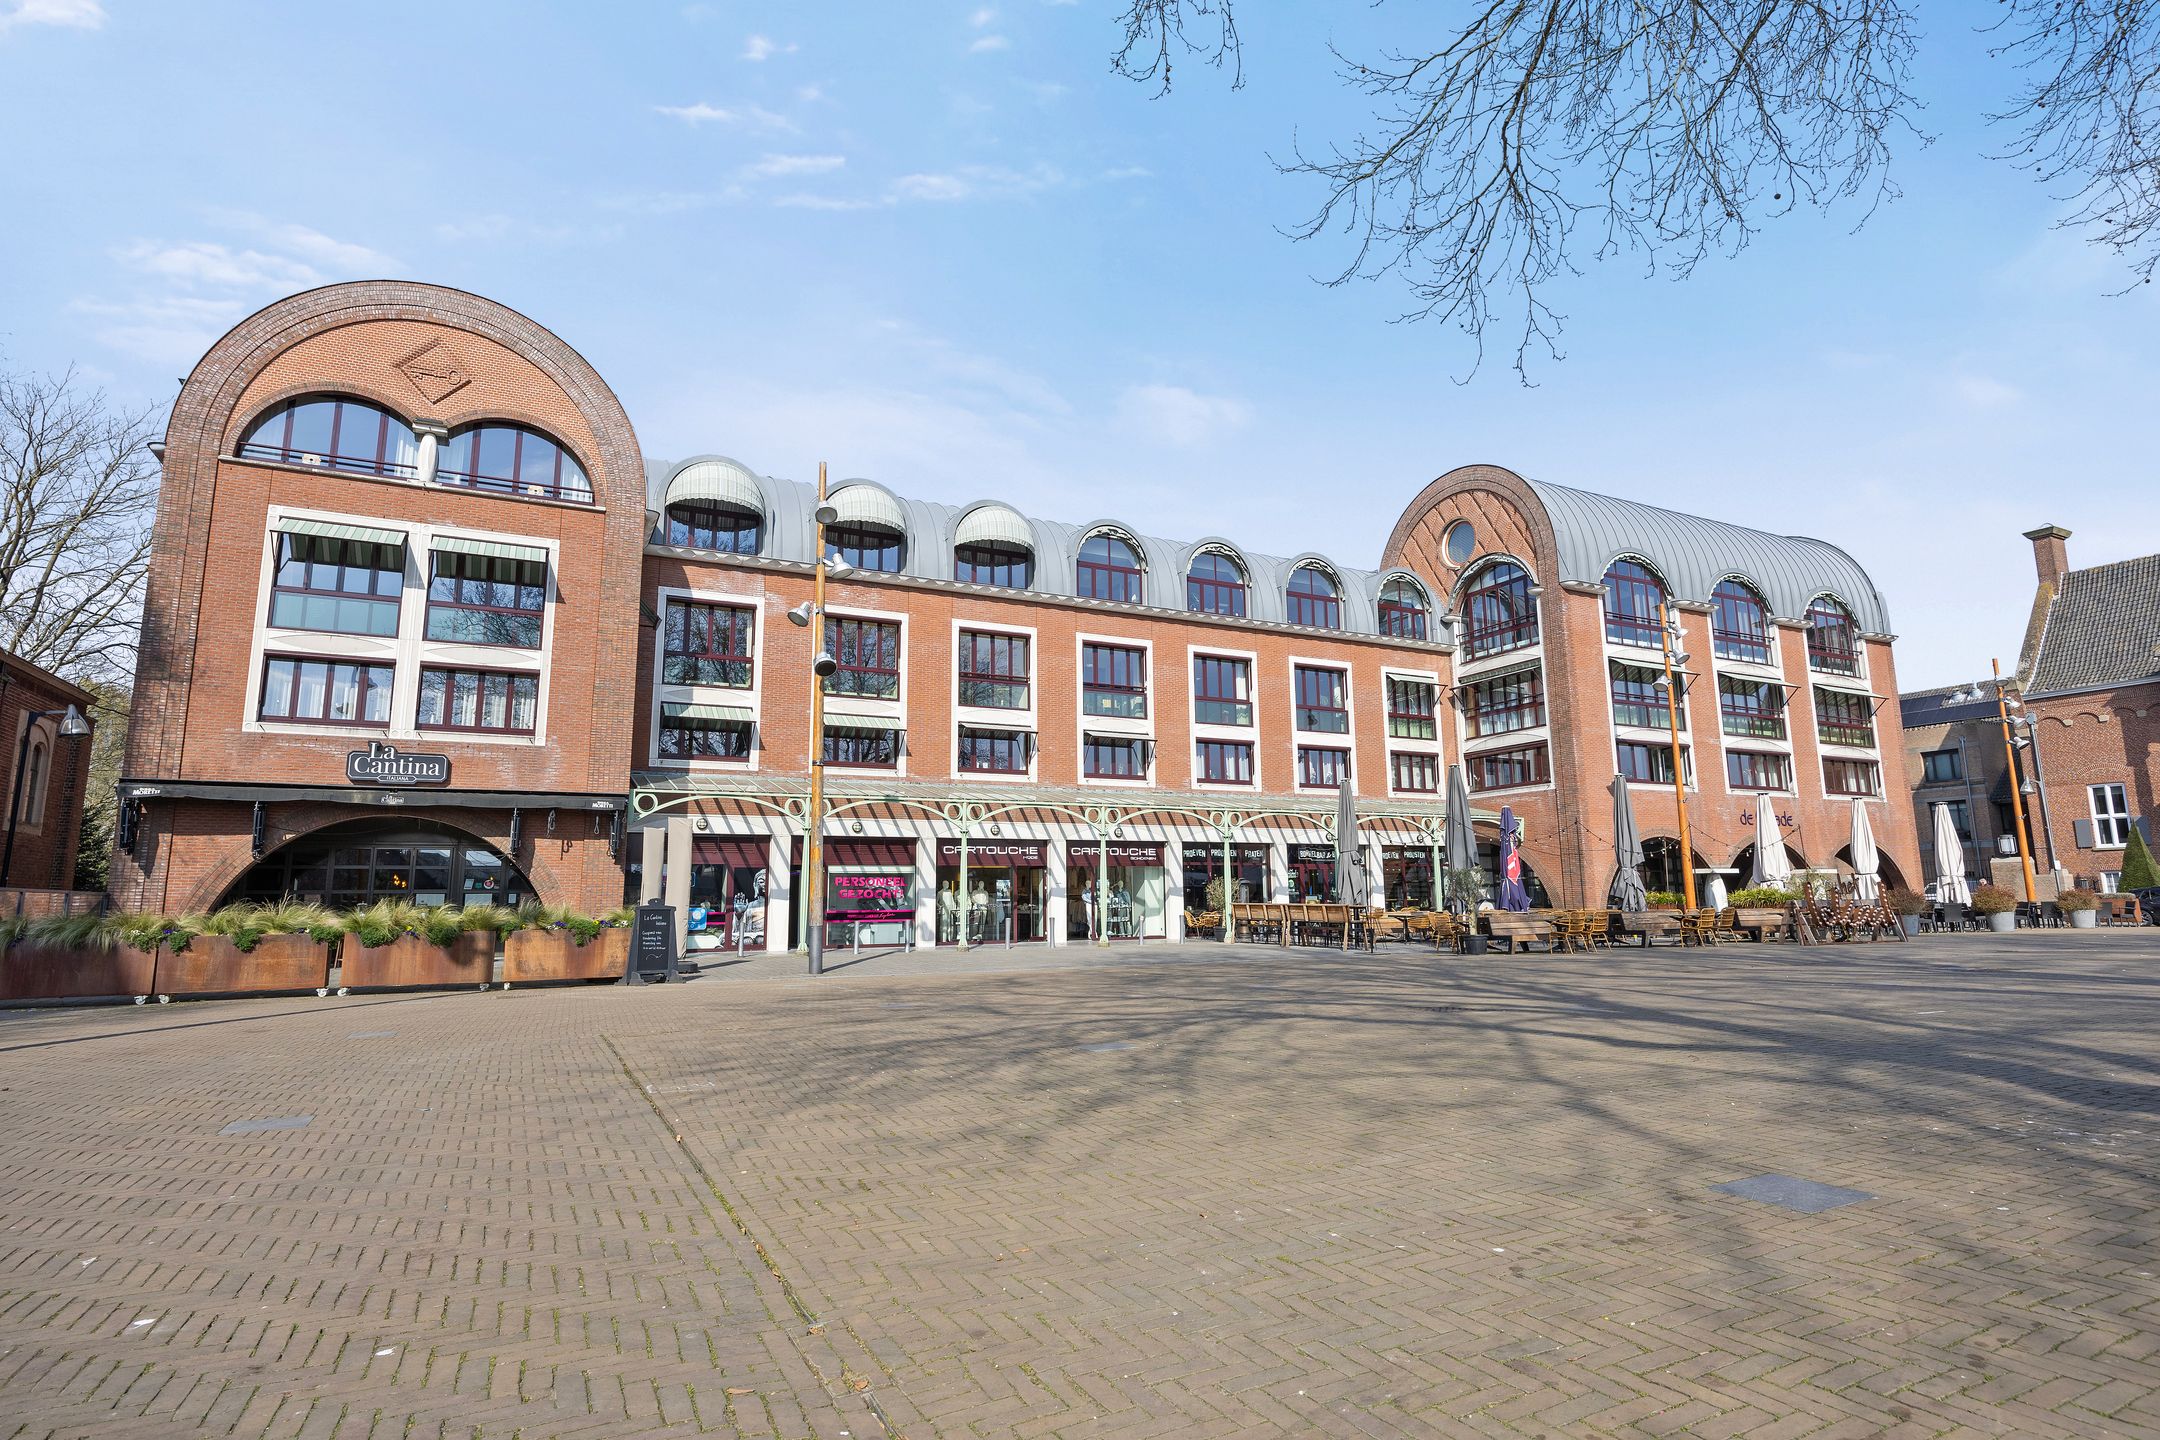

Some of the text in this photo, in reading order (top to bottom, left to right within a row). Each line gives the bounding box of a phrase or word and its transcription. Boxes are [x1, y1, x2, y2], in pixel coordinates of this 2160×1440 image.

[370, 742, 395, 759] La
[354, 756, 440, 776] Cantina
[1740, 809, 1794, 827] de ade
[943, 846, 1038, 855] CARTOUCHE
[1183, 849, 1264, 858] PROEVEN PROOEN PRATEN
[834, 877, 908, 886] PERSONEEL
[839, 889, 904, 898] GEZOCHT!
